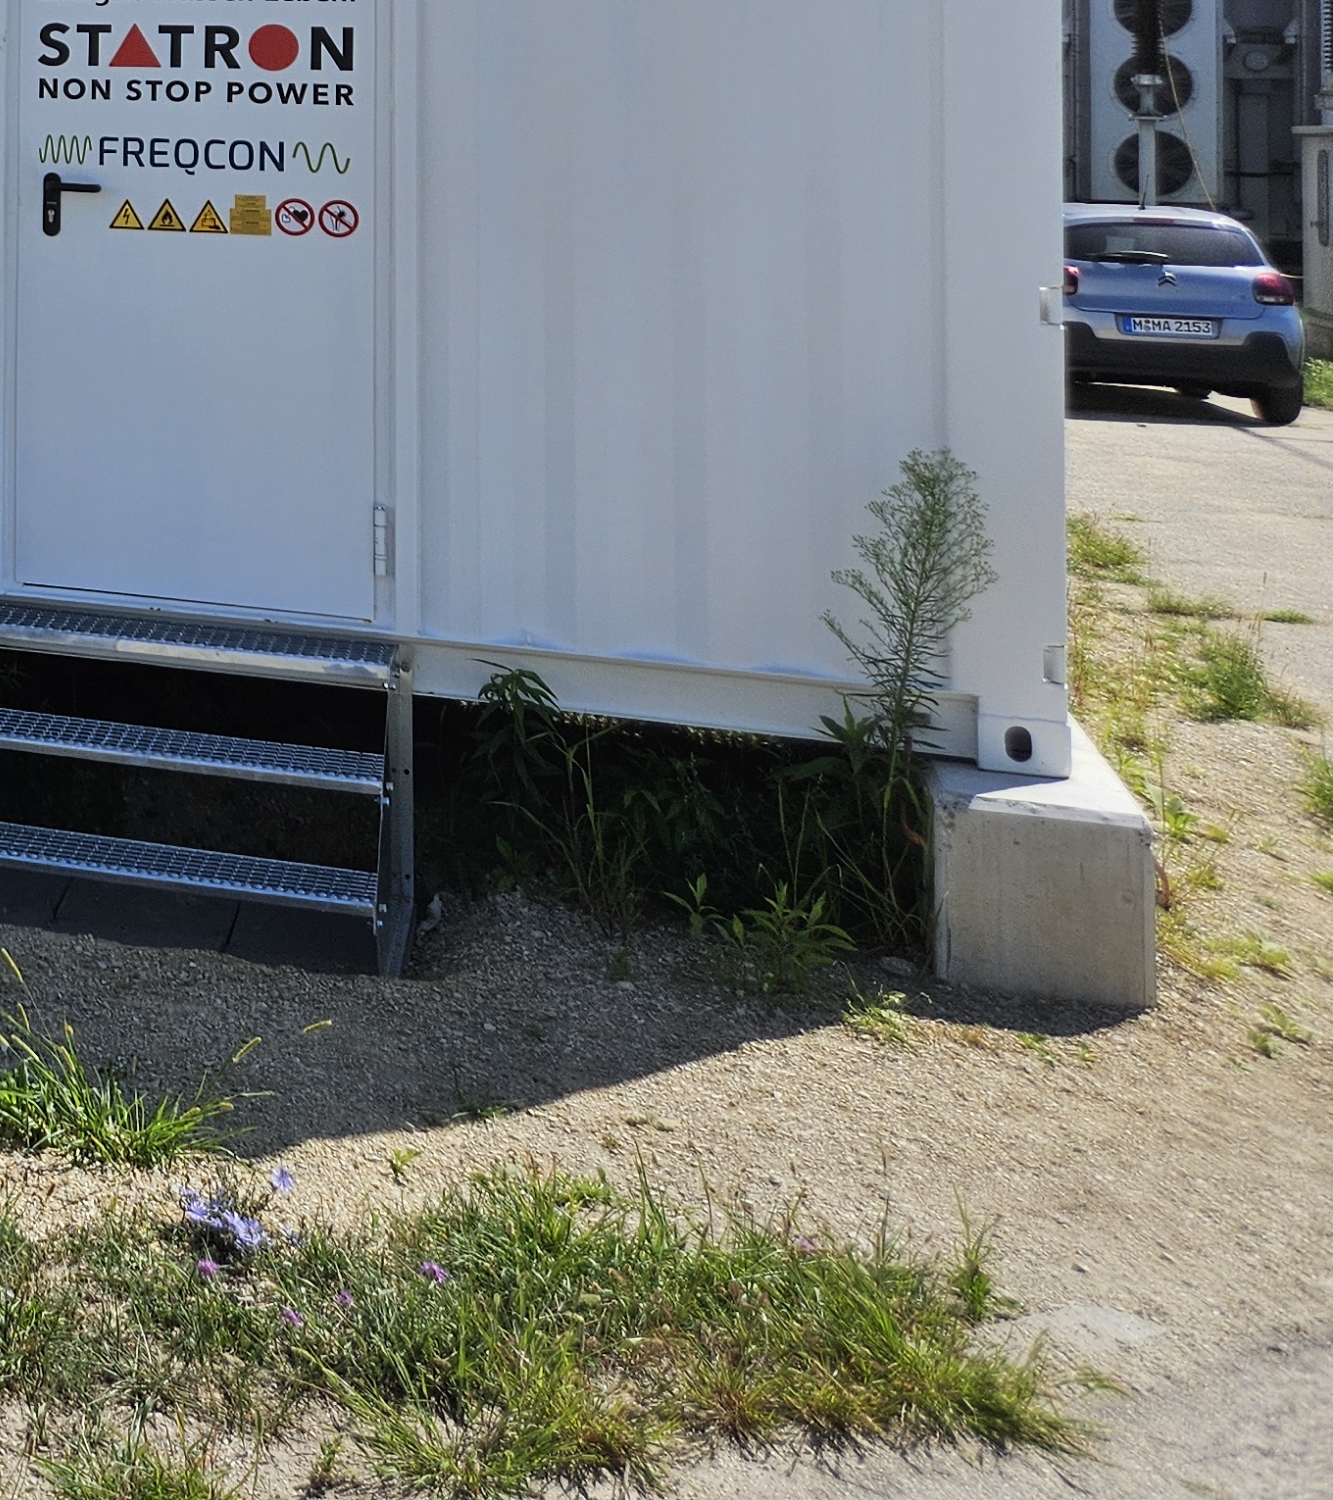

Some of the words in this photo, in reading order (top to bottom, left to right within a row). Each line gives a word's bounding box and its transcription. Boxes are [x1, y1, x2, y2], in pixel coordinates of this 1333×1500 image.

[37, 22, 354, 72] STATRON
[38, 78, 111, 100] NON
[125, 79, 212, 102] STOP
[226, 81, 354, 106] POWER
[98, 136, 285, 175] FREQCON
[1174, 321, 1211, 333] 2153
